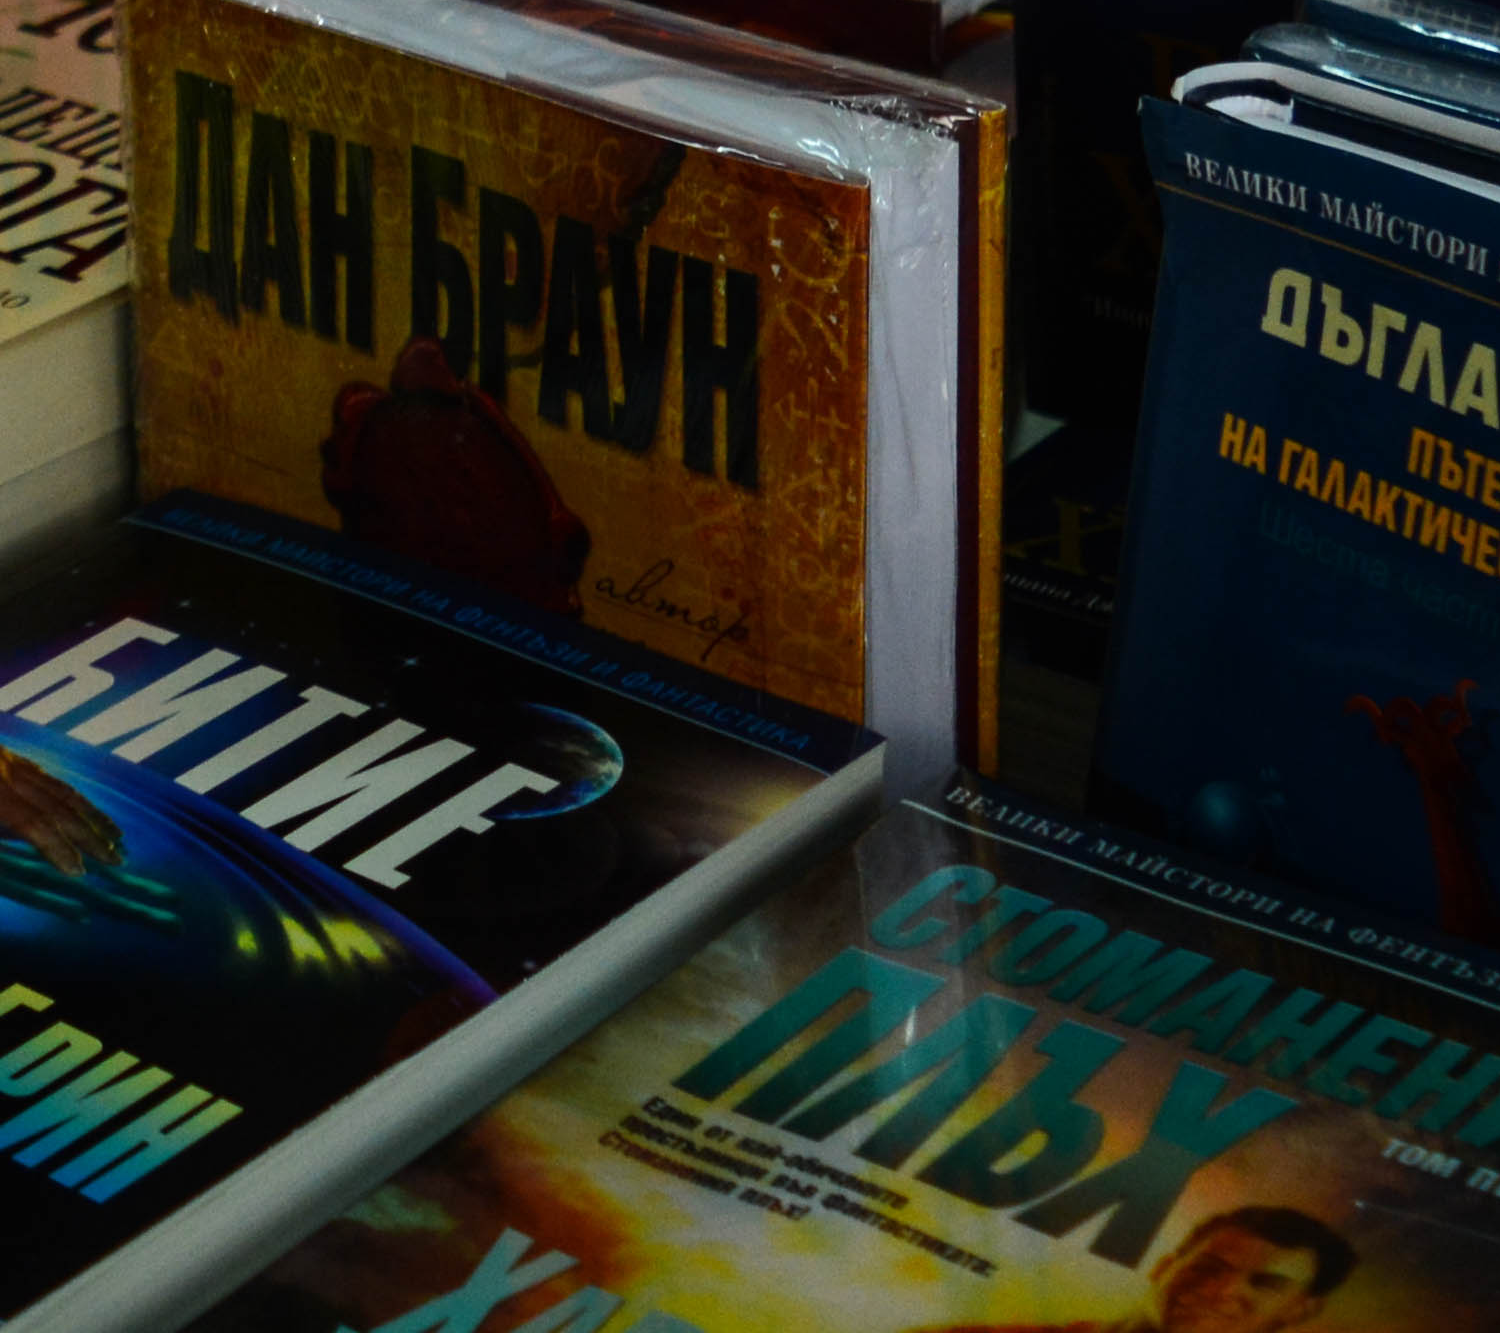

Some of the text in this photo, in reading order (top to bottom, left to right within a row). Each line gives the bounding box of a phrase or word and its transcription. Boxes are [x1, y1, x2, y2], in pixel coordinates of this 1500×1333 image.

[167, 68, 378, 359] ДАН
[408, 142, 760, 492] БРАУН
[1184, 150, 1309, 213] ВЕЛИКИ
[1318, 193, 1490, 277] МАЙСТОРИ
[1217, 411, 1270, 477] НА
[398, 575, 450, 611] НА
[452, 594, 591, 675] ФЕНТЪЗИ
[594, 657, 616, 684] И
[618, 665, 812, 753] ФАНТАСТИКА
[594, 556, 752, 664] автор
[945, 781, 1073, 841] ВЕЛИКИ
[1083, 833, 1280, 921] МАЙСТОРИ
[1288, 902, 1340, 936] НА
[671, 944, 1298, 1270] ПЛЪХ
[1379, 1135, 1462, 1189] ТОМ
